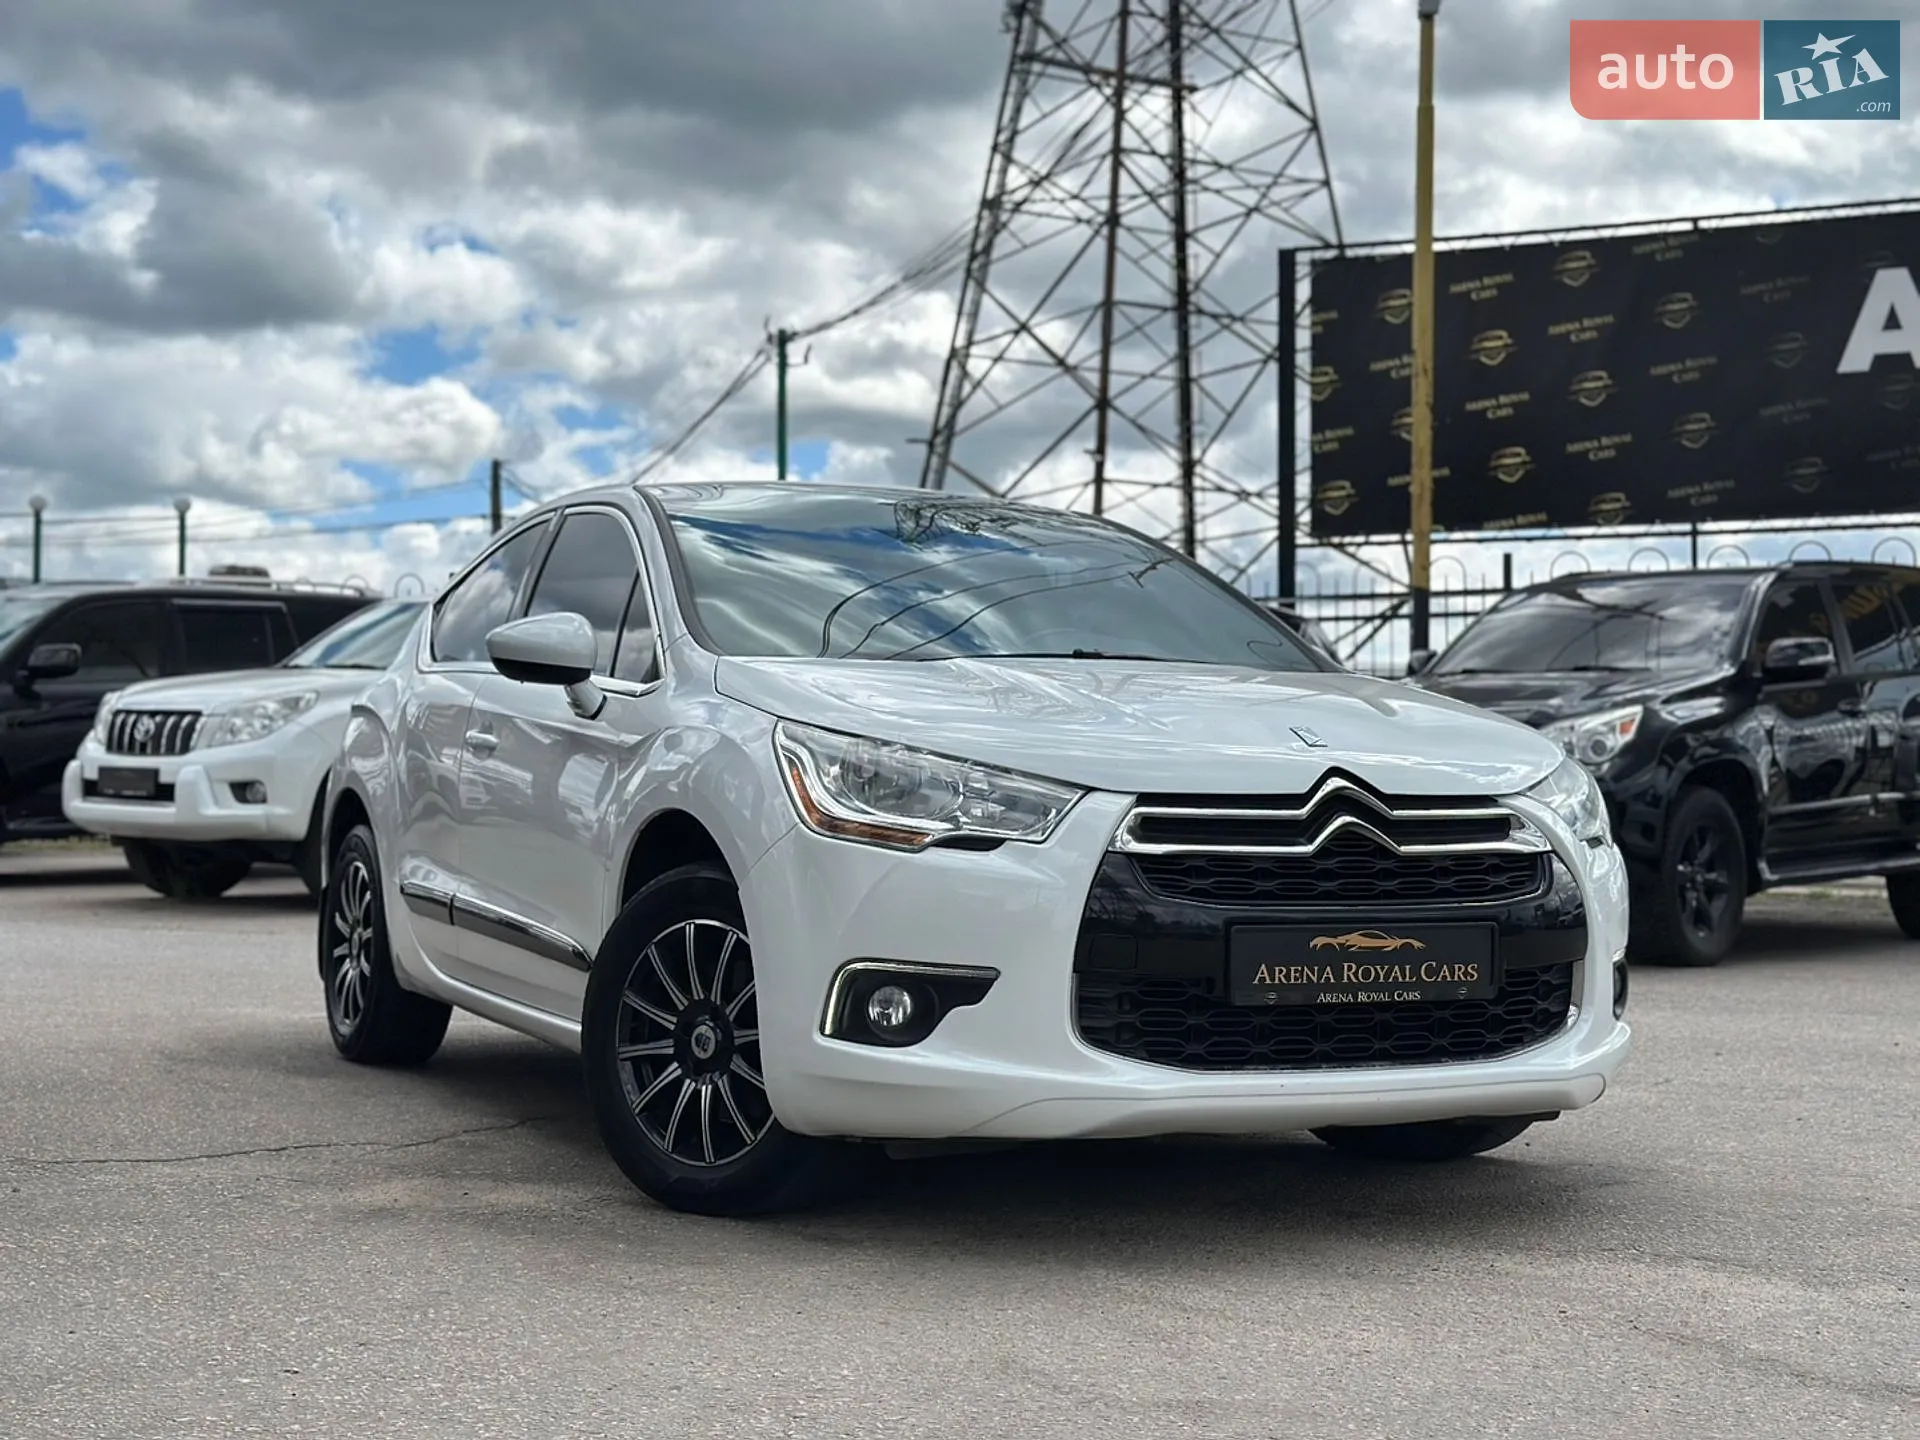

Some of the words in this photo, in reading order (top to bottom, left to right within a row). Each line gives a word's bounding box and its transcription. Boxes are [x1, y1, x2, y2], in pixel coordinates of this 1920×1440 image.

[1252, 963, 1335, 985] ARENA
[1342, 962, 1416, 983] ROYAL
[1421, 960, 1478, 981] CARS
